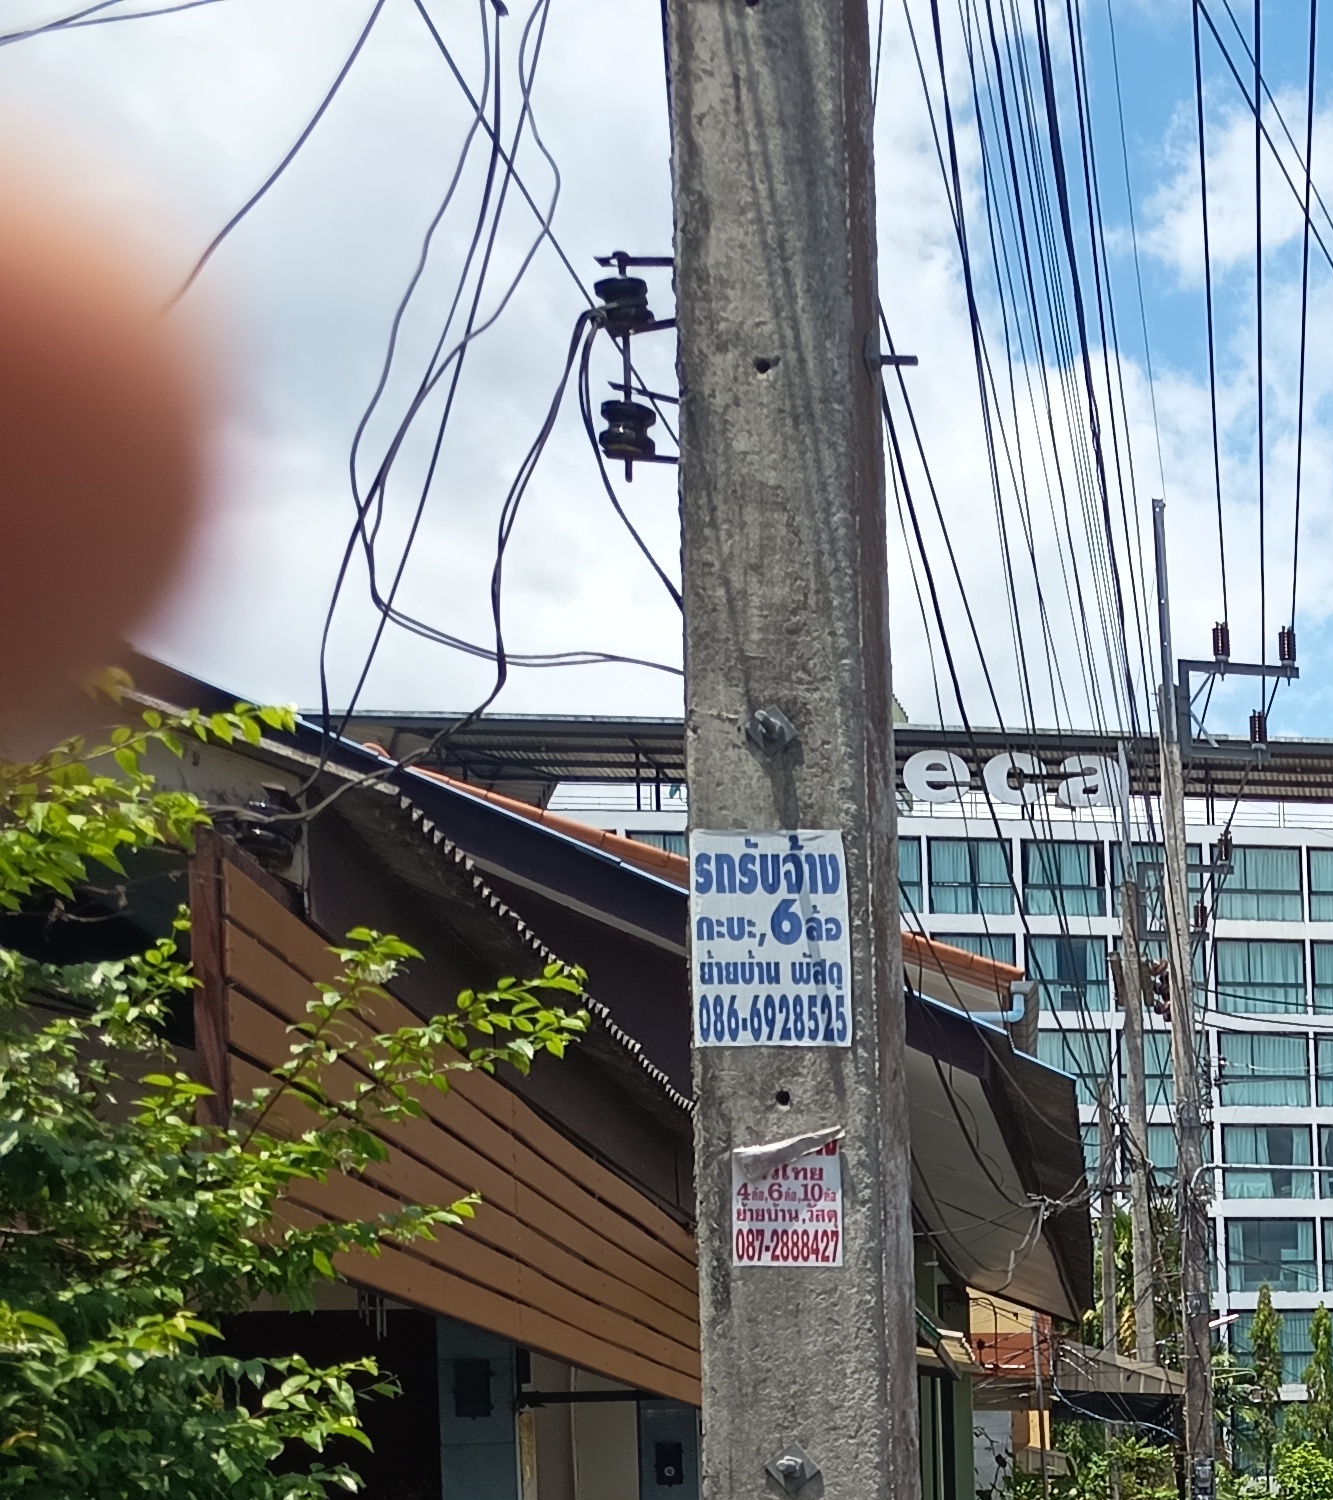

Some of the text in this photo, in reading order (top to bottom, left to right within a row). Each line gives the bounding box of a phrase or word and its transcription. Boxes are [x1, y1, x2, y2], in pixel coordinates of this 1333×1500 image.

[903, 750, 1122, 807] eca
[695, 835, 841, 895] รถรับจ้าง
[700, 950, 843, 990] ย้ายบ้าน พัสดุ
[699, 994, 847, 1042] 086-6928525
[736, 1228, 839, 1262] 087-2888427
